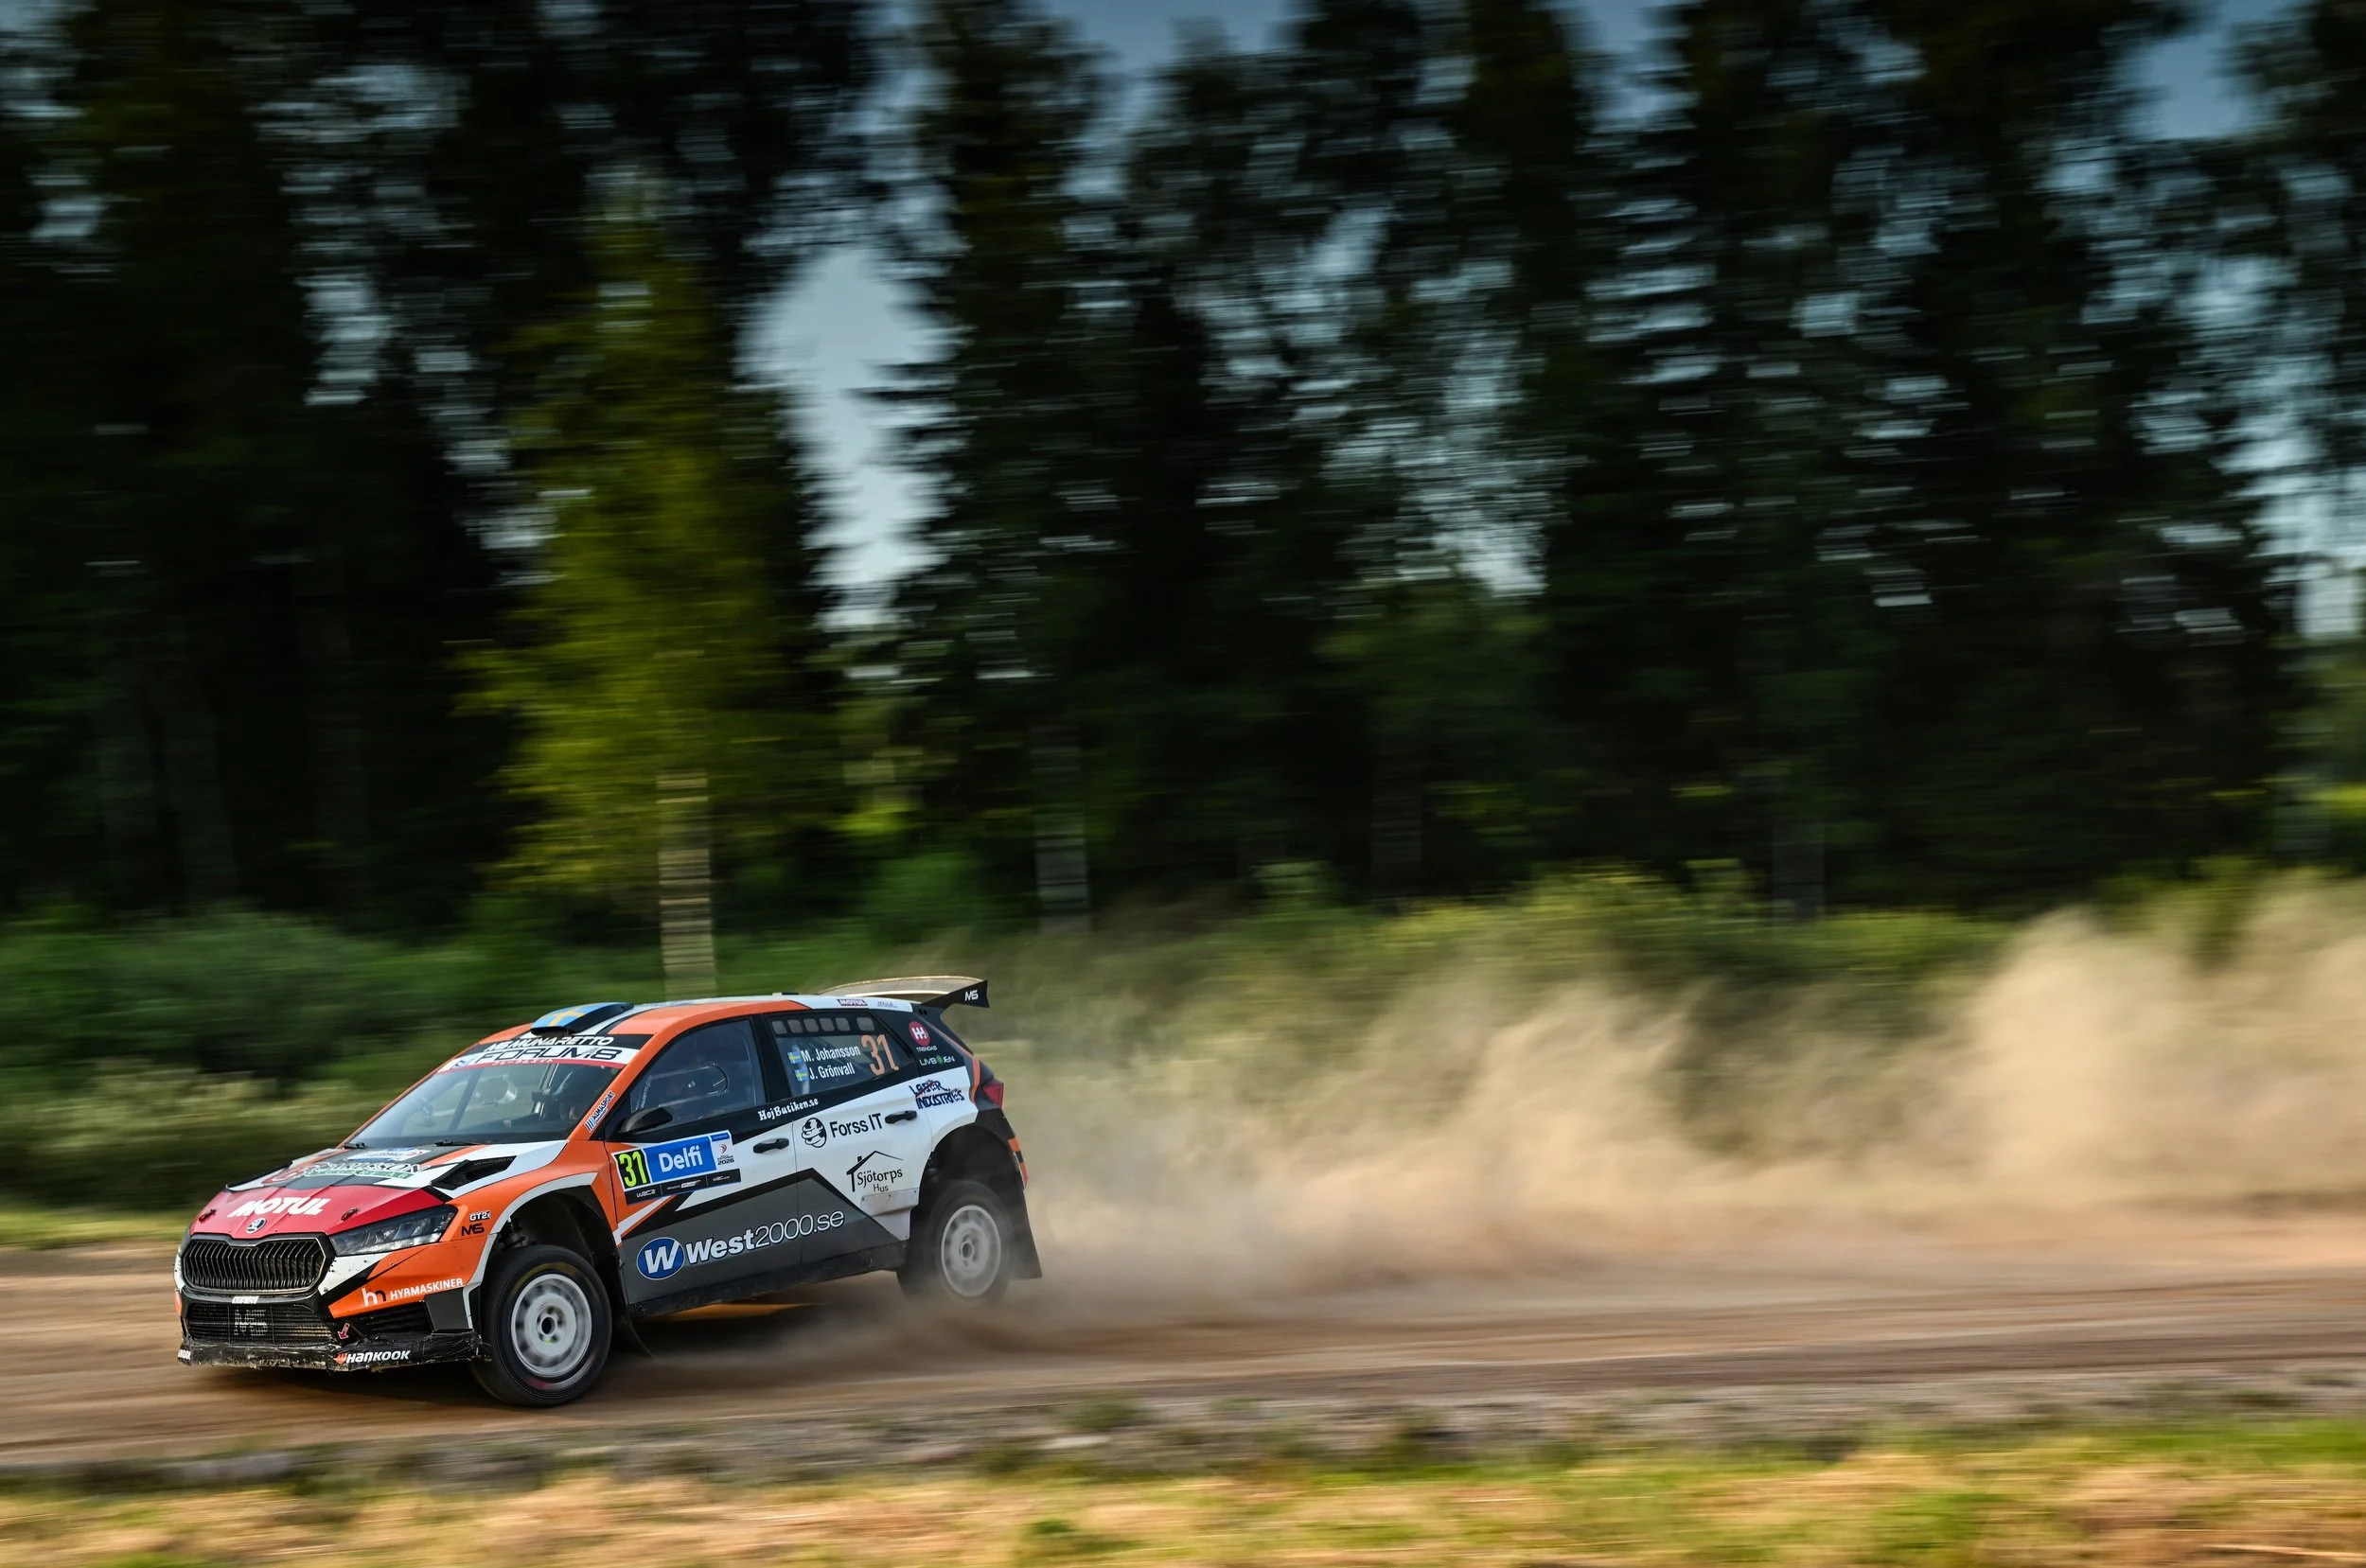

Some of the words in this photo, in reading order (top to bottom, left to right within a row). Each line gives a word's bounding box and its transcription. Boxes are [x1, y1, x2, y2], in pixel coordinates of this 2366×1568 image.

[509, 1036, 613, 1049] MUNARETTO
[475, 1048, 623, 1064] FORUM8
[801, 1049, 814, 1064] M.
[815, 1045, 861, 1062] Johansson
[860, 1034, 899, 1076] 31
[809, 1066, 818, 1080] J.
[820, 1062, 856, 1079] Grönvall
[758, 1098, 819, 1120] HojButiken.se
[915, 1089, 964, 1109] INDUSTRIES
[830, 1119, 869, 1137] Forss
[869, 1113, 882, 1131] IT
[659, 1145, 703, 1172] Delfi
[619, 1151, 647, 1188] 31
[857, 1169, 903, 1188] Sjötorps
[636, 1189, 656, 1198] WRC2
[874, 1184, 889, 1192] Hus
[227, 1197, 331, 1218] MOTUL
[685, 1210, 845, 1264] West2000.se
[390, 1278, 464, 1300] HYRMASKINER
